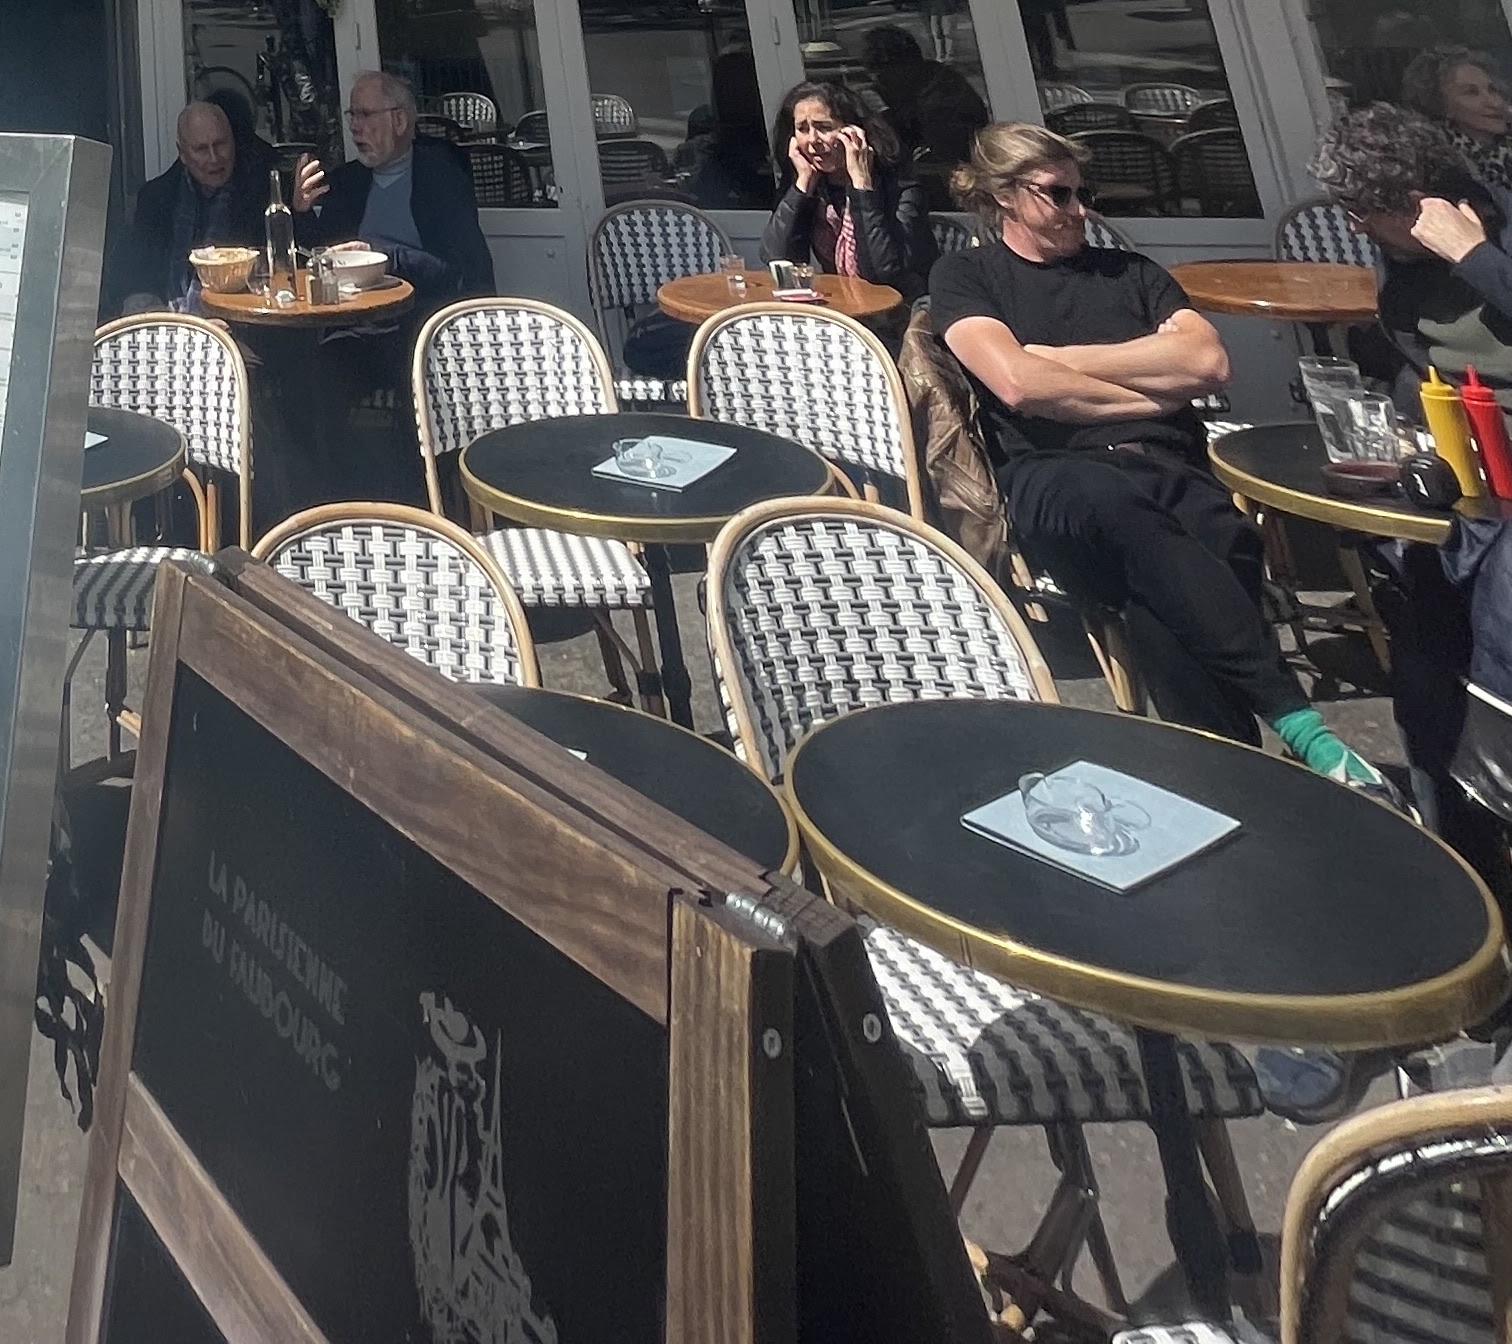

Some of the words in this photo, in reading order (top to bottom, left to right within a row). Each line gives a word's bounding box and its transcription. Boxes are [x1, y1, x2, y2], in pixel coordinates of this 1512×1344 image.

[202, 908, 226, 964] DU
[230, 938, 341, 1092] FAUBOURG
[233, 875, 348, 1026] PARISIENNE
